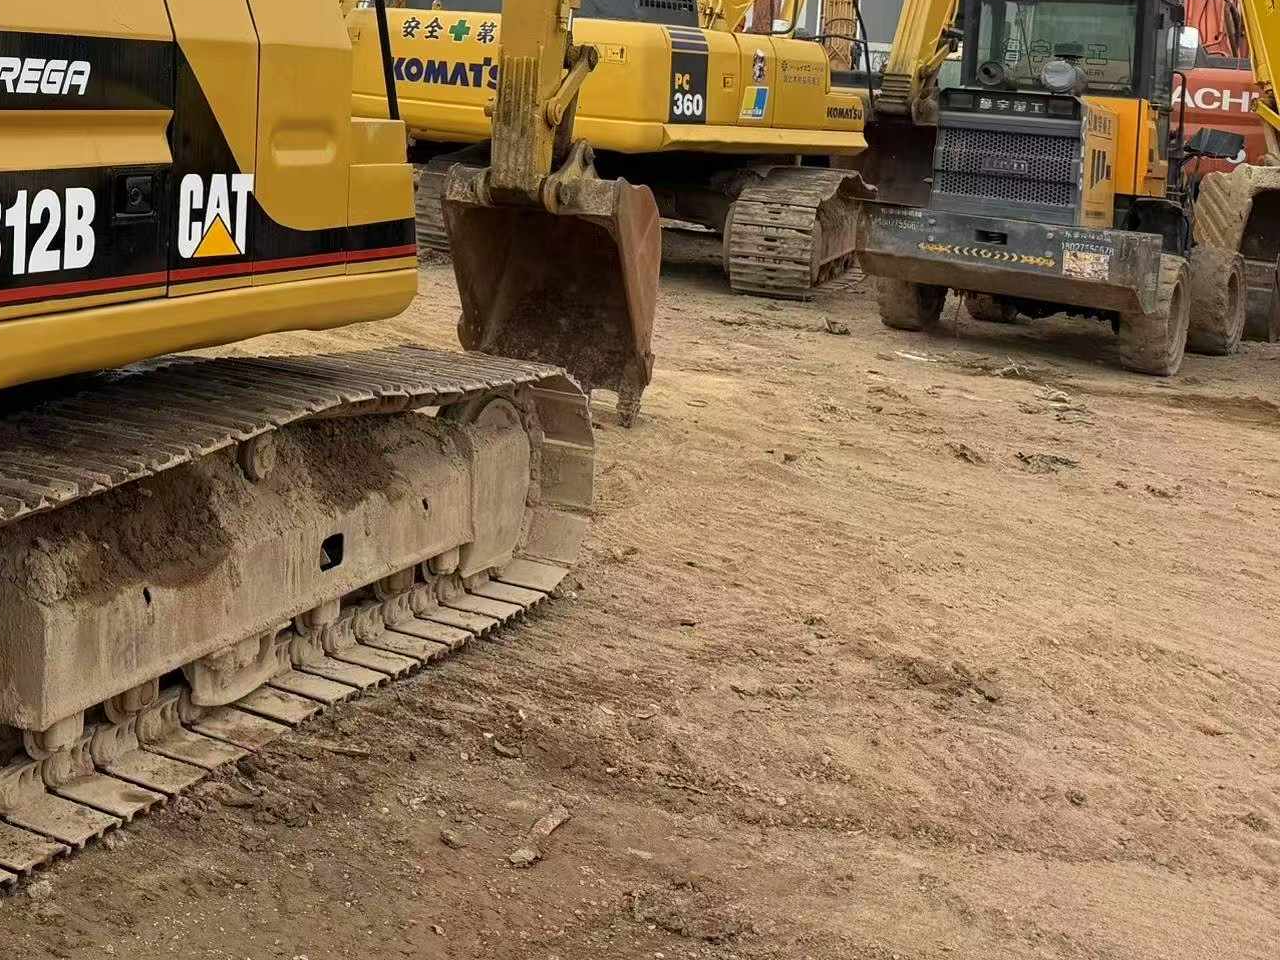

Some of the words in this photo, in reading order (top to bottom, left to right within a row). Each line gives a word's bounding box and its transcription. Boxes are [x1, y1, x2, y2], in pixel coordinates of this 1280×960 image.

[391, 56, 499, 90] KOMATS
[674, 72, 690, 90] PC
[673, 93, 703, 117] 360
[826, 105, 863, 120] KOMATSU
[178, 173, 255, 259] CAT
